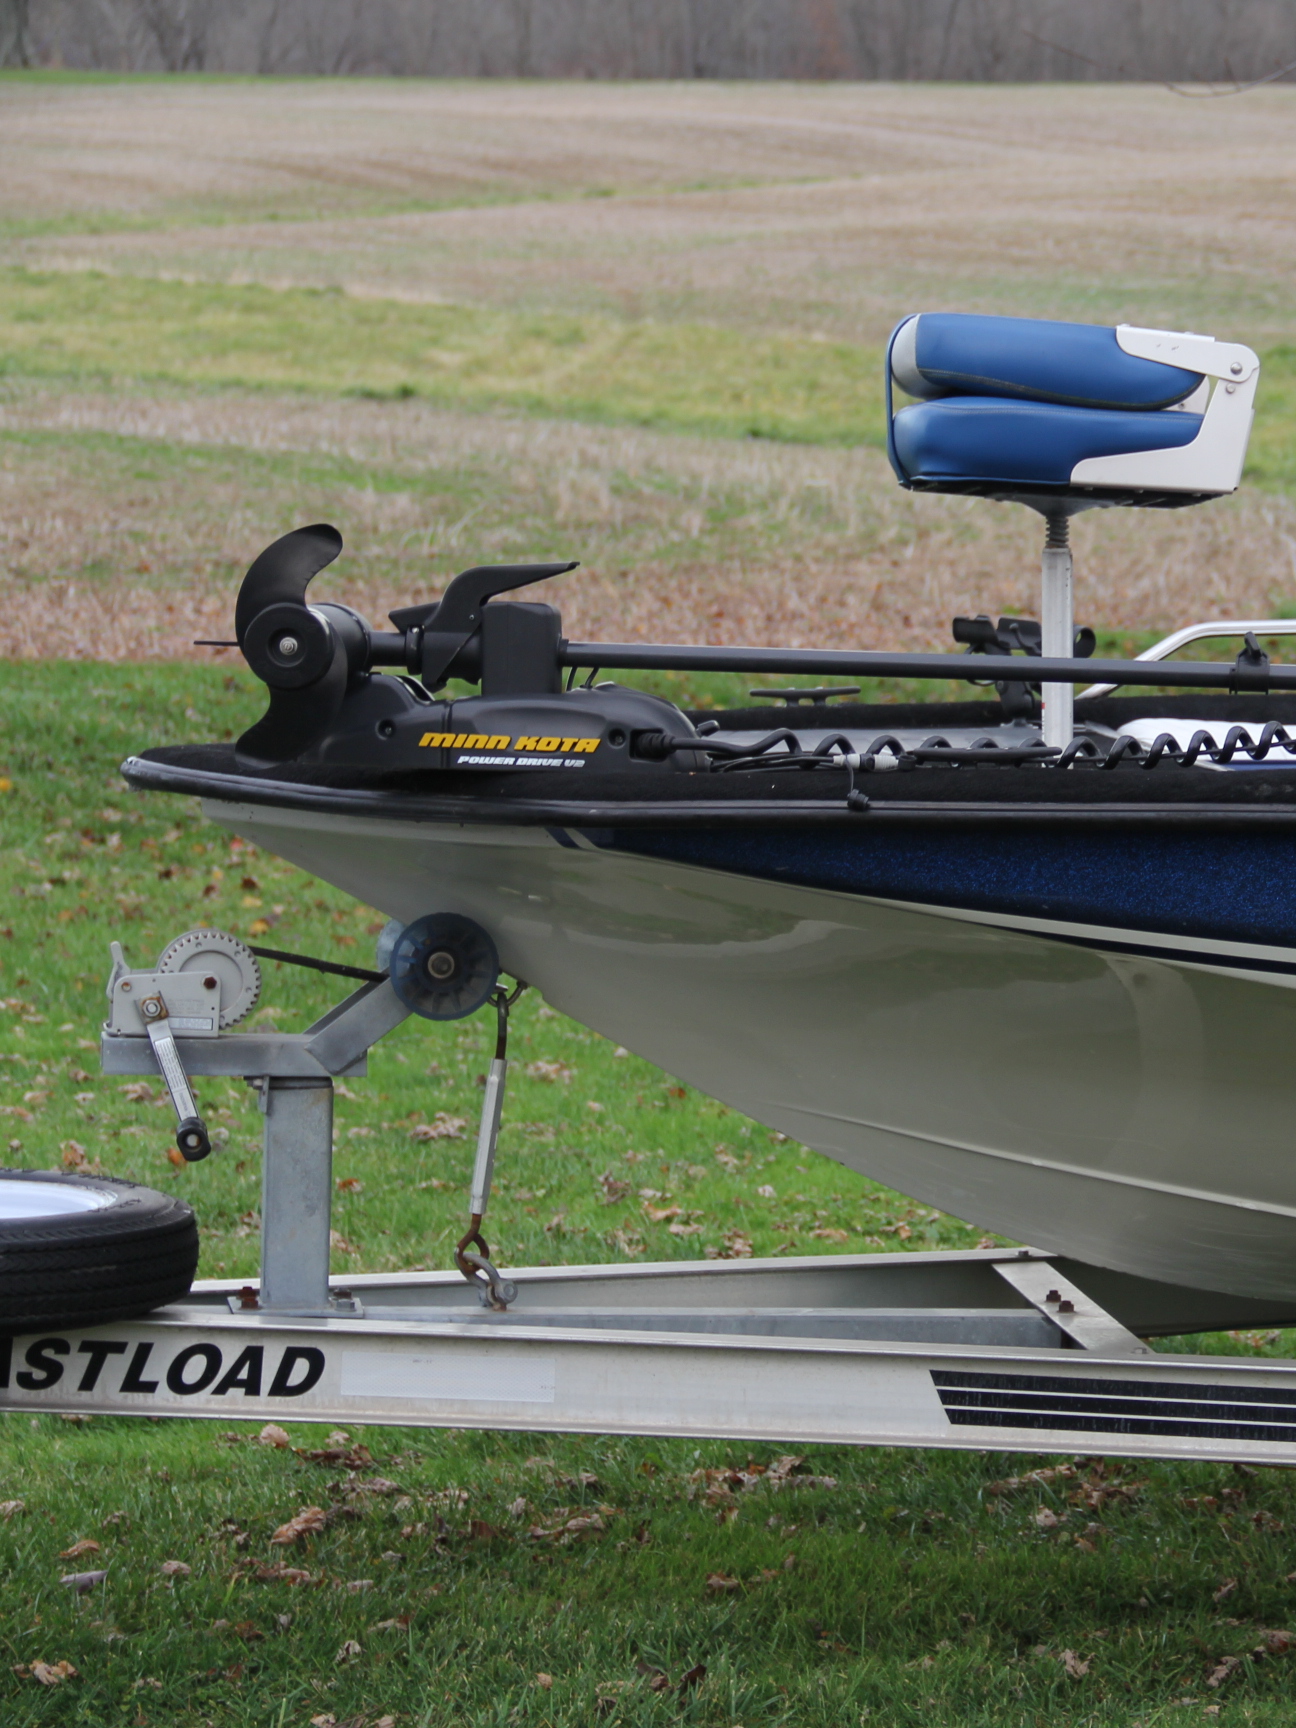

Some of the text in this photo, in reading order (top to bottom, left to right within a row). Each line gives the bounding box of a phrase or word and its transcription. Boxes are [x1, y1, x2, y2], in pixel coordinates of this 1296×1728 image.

[418, 732, 601, 753] MINN KOTA
[457, 755, 586, 768] POWER DRIVE V2
